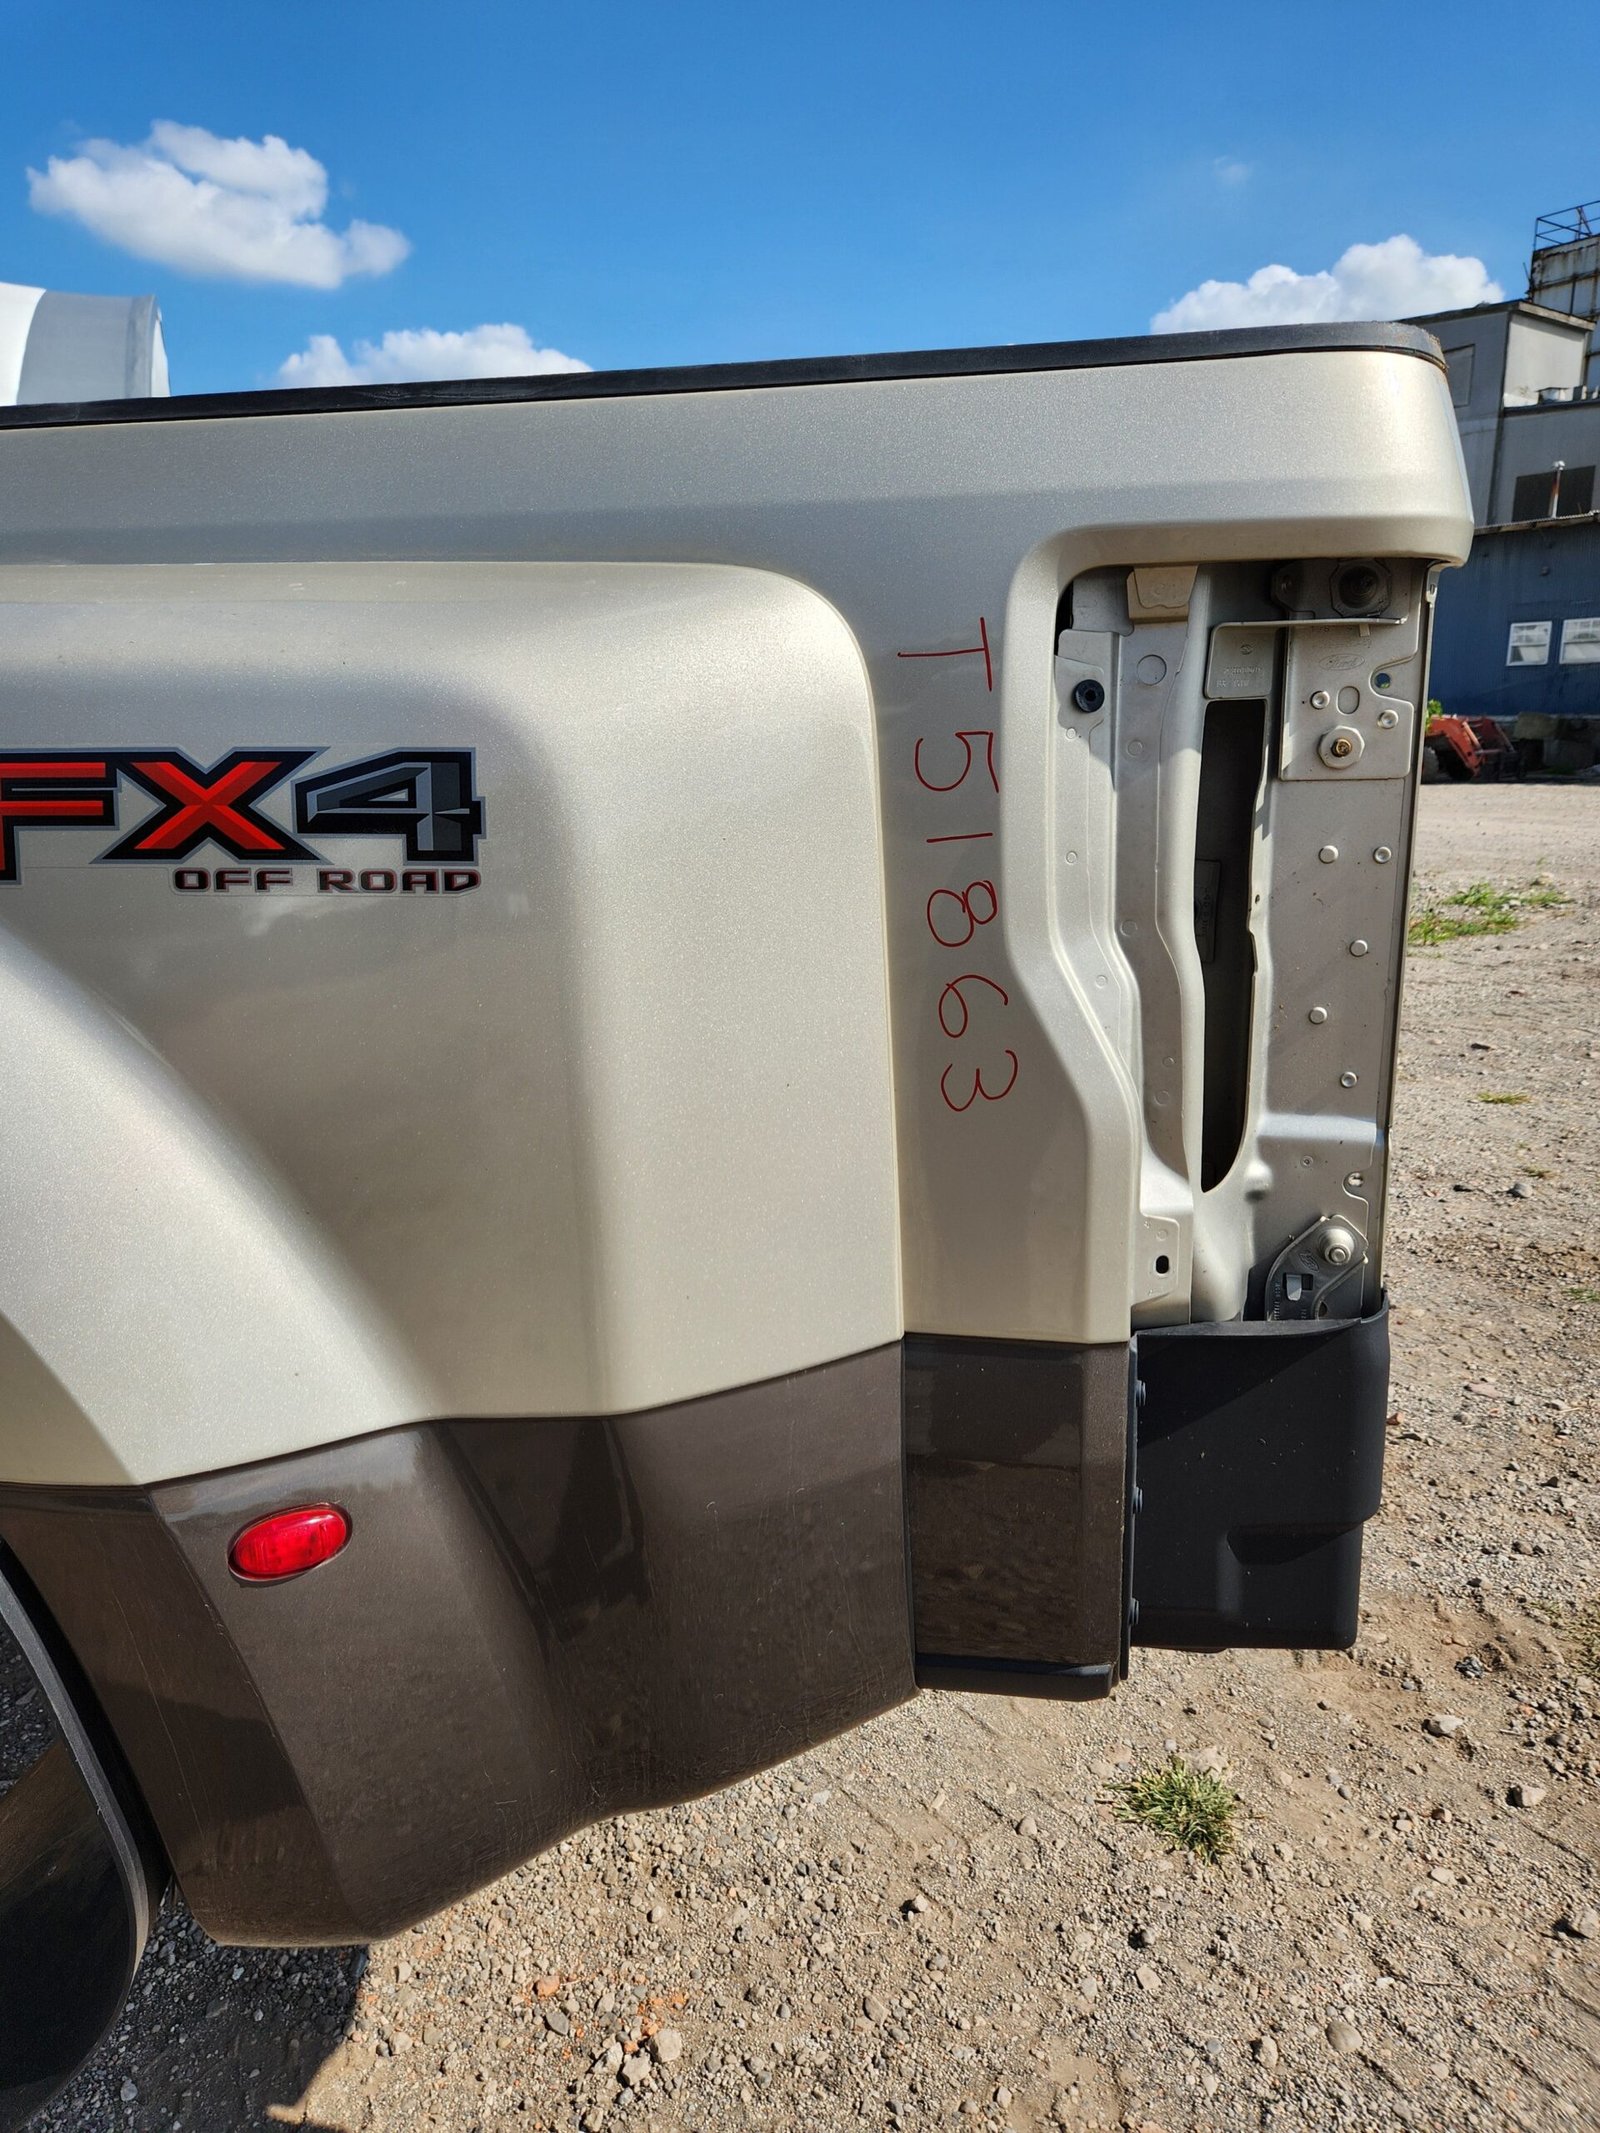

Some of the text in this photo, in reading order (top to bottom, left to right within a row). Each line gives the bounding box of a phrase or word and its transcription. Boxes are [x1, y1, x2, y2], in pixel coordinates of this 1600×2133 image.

[0, 747, 486, 886] FX4
[173, 868, 482, 893] OFF ROAD
